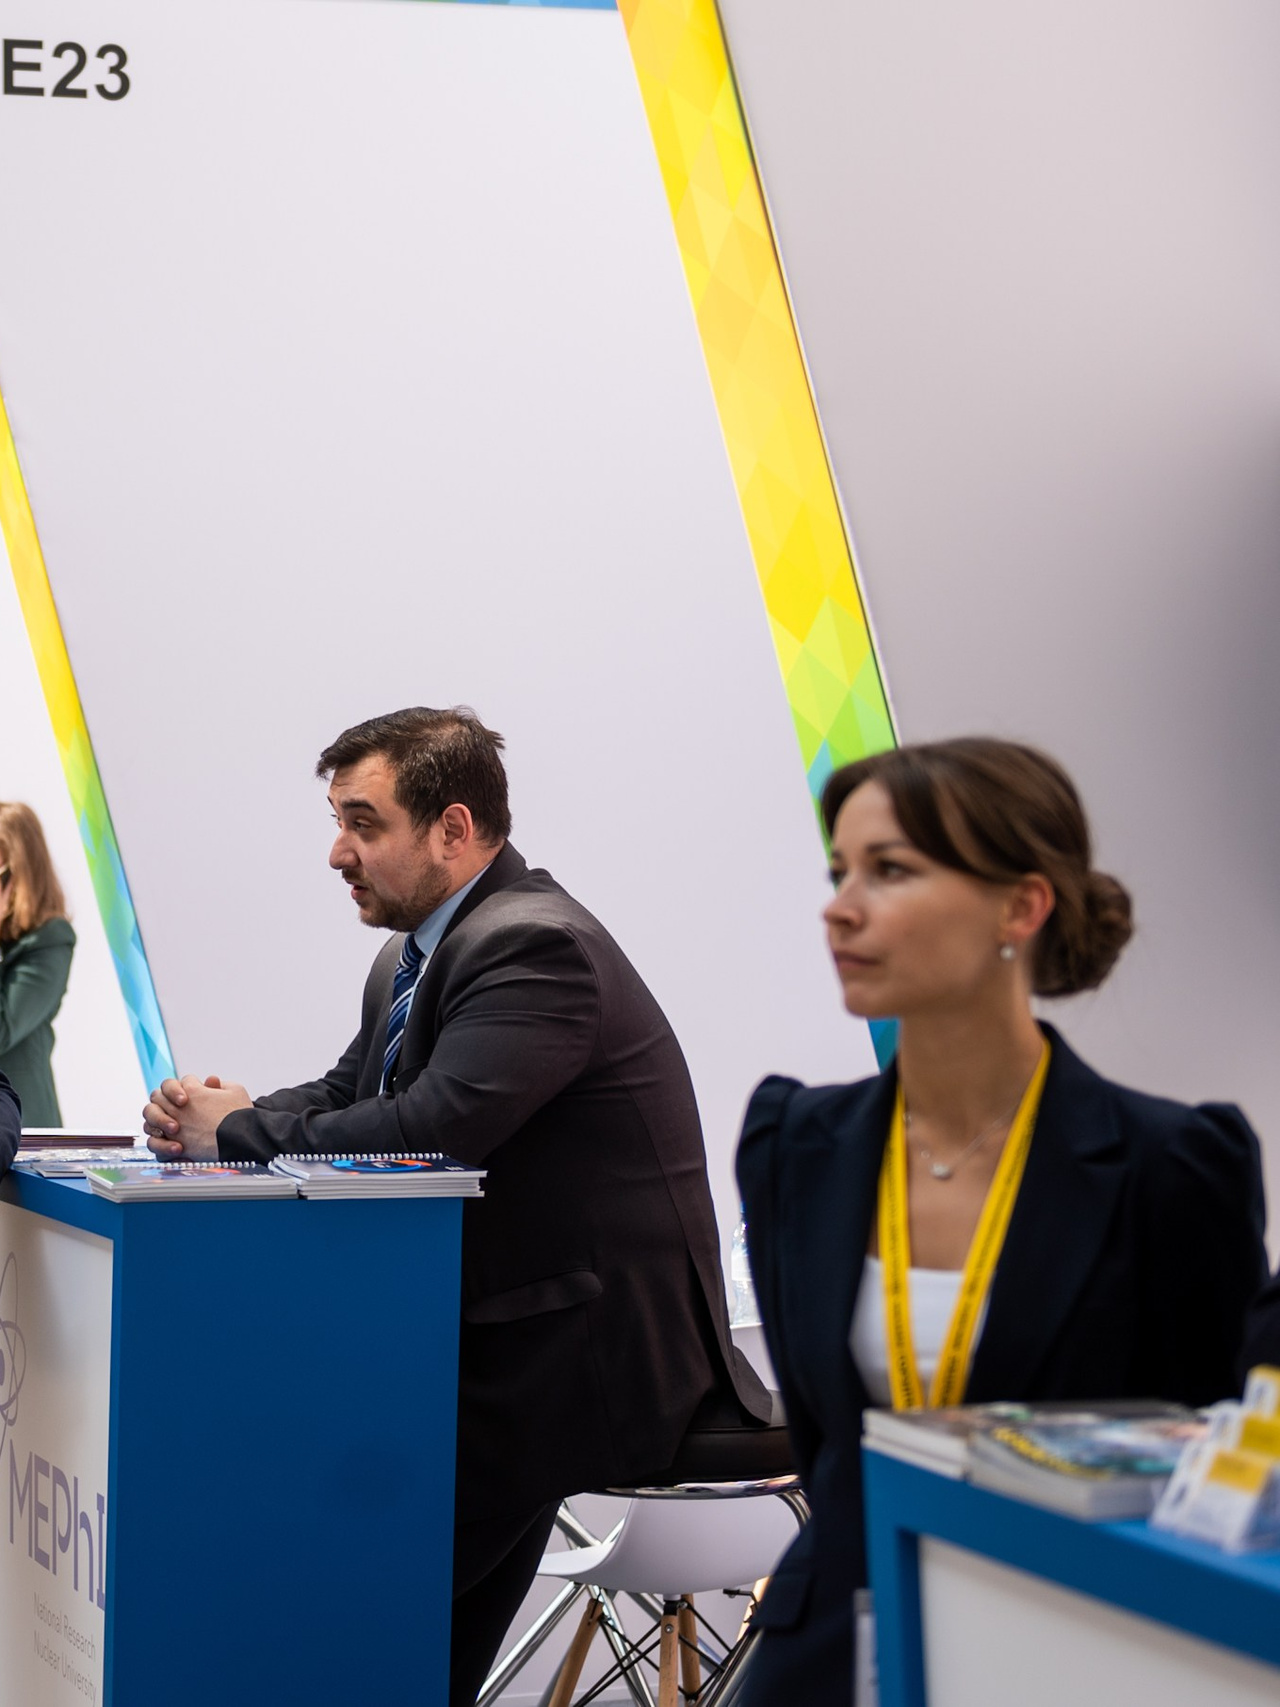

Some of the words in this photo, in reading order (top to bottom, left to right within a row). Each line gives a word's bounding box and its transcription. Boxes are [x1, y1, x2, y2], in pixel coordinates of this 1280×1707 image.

[2, 38, 131, 101] E23
[9, 1438, 105, 1611] MEPhI
[33, 1591, 63, 1636] National
[63, 1614, 97, 1664] Research
[33, 1629, 61, 1673] Nuclear
[61, 1651, 98, 1707] University
